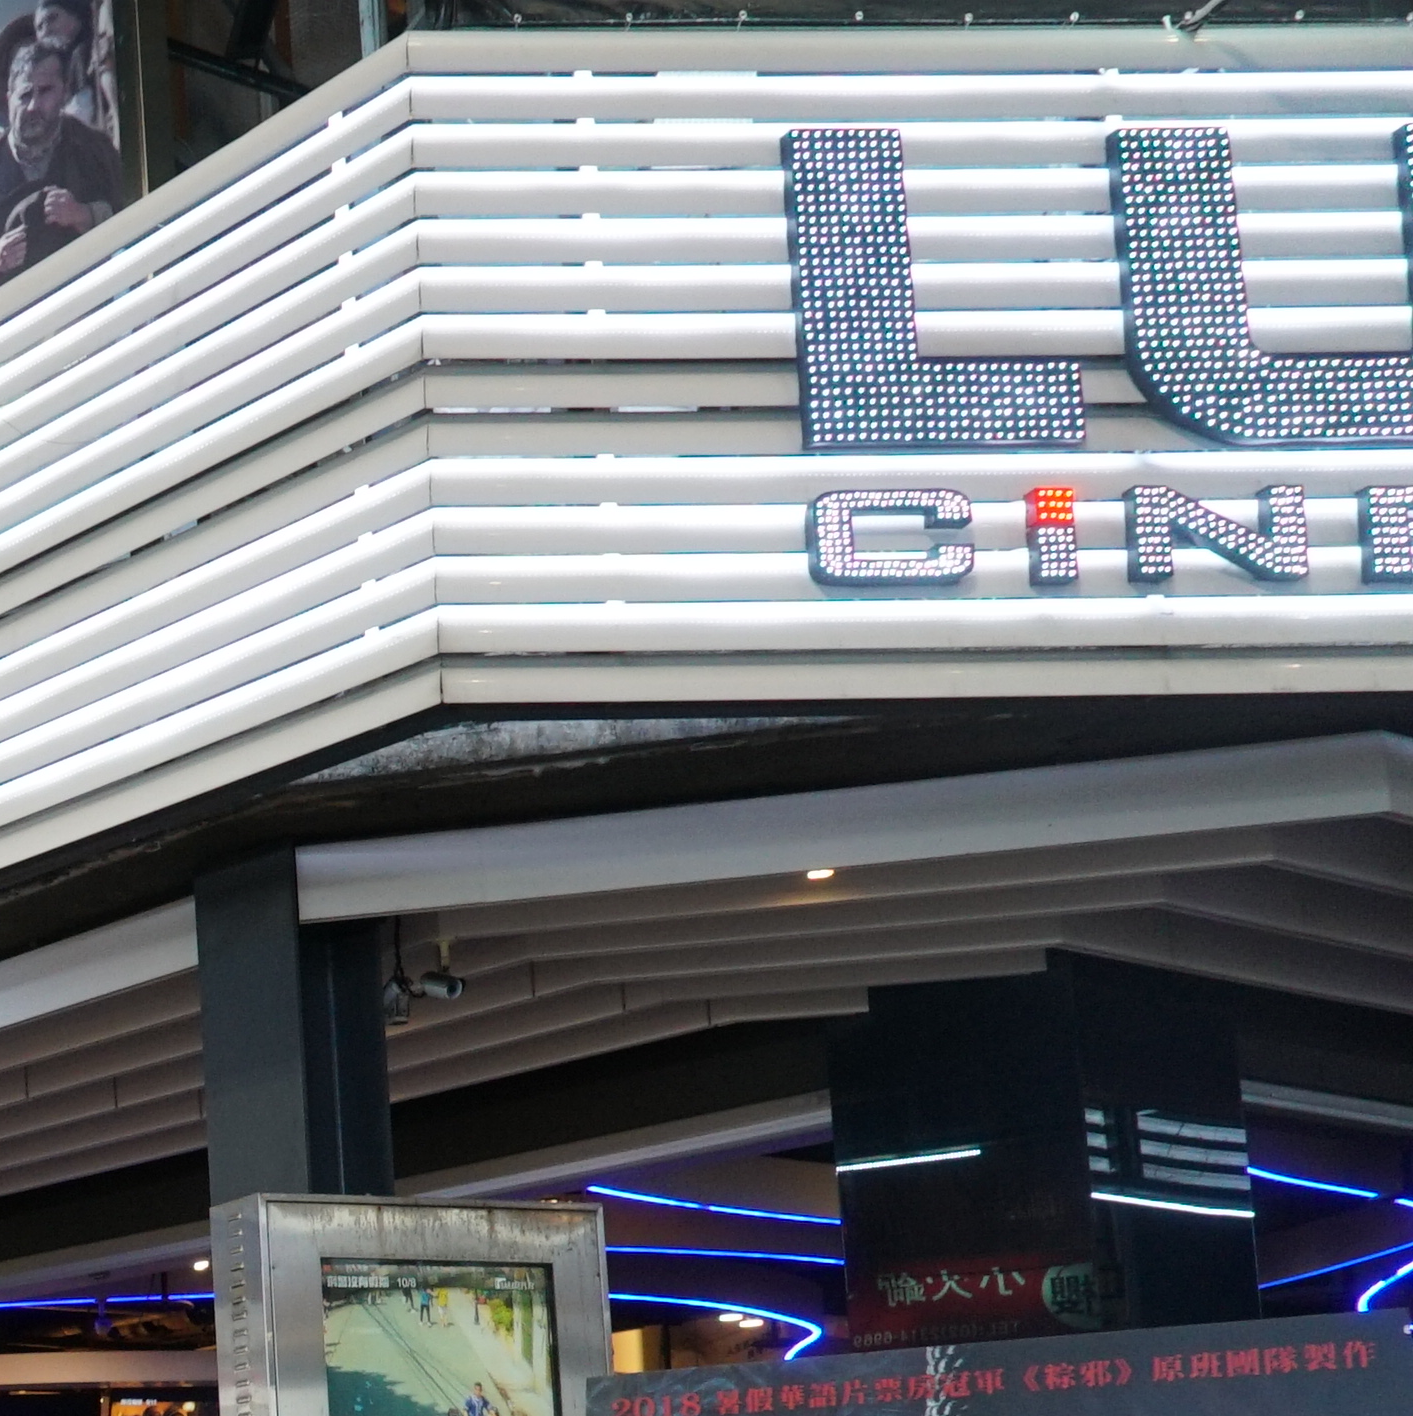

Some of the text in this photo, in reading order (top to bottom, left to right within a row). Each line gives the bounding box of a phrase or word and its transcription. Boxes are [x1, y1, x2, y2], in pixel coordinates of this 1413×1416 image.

[780, 126, 1413, 450] LU
[716, 1368, 1006, 1416] 暑假華語片票房冠軍
[1152, 1341, 1376, 1383] 原班團隊製作
